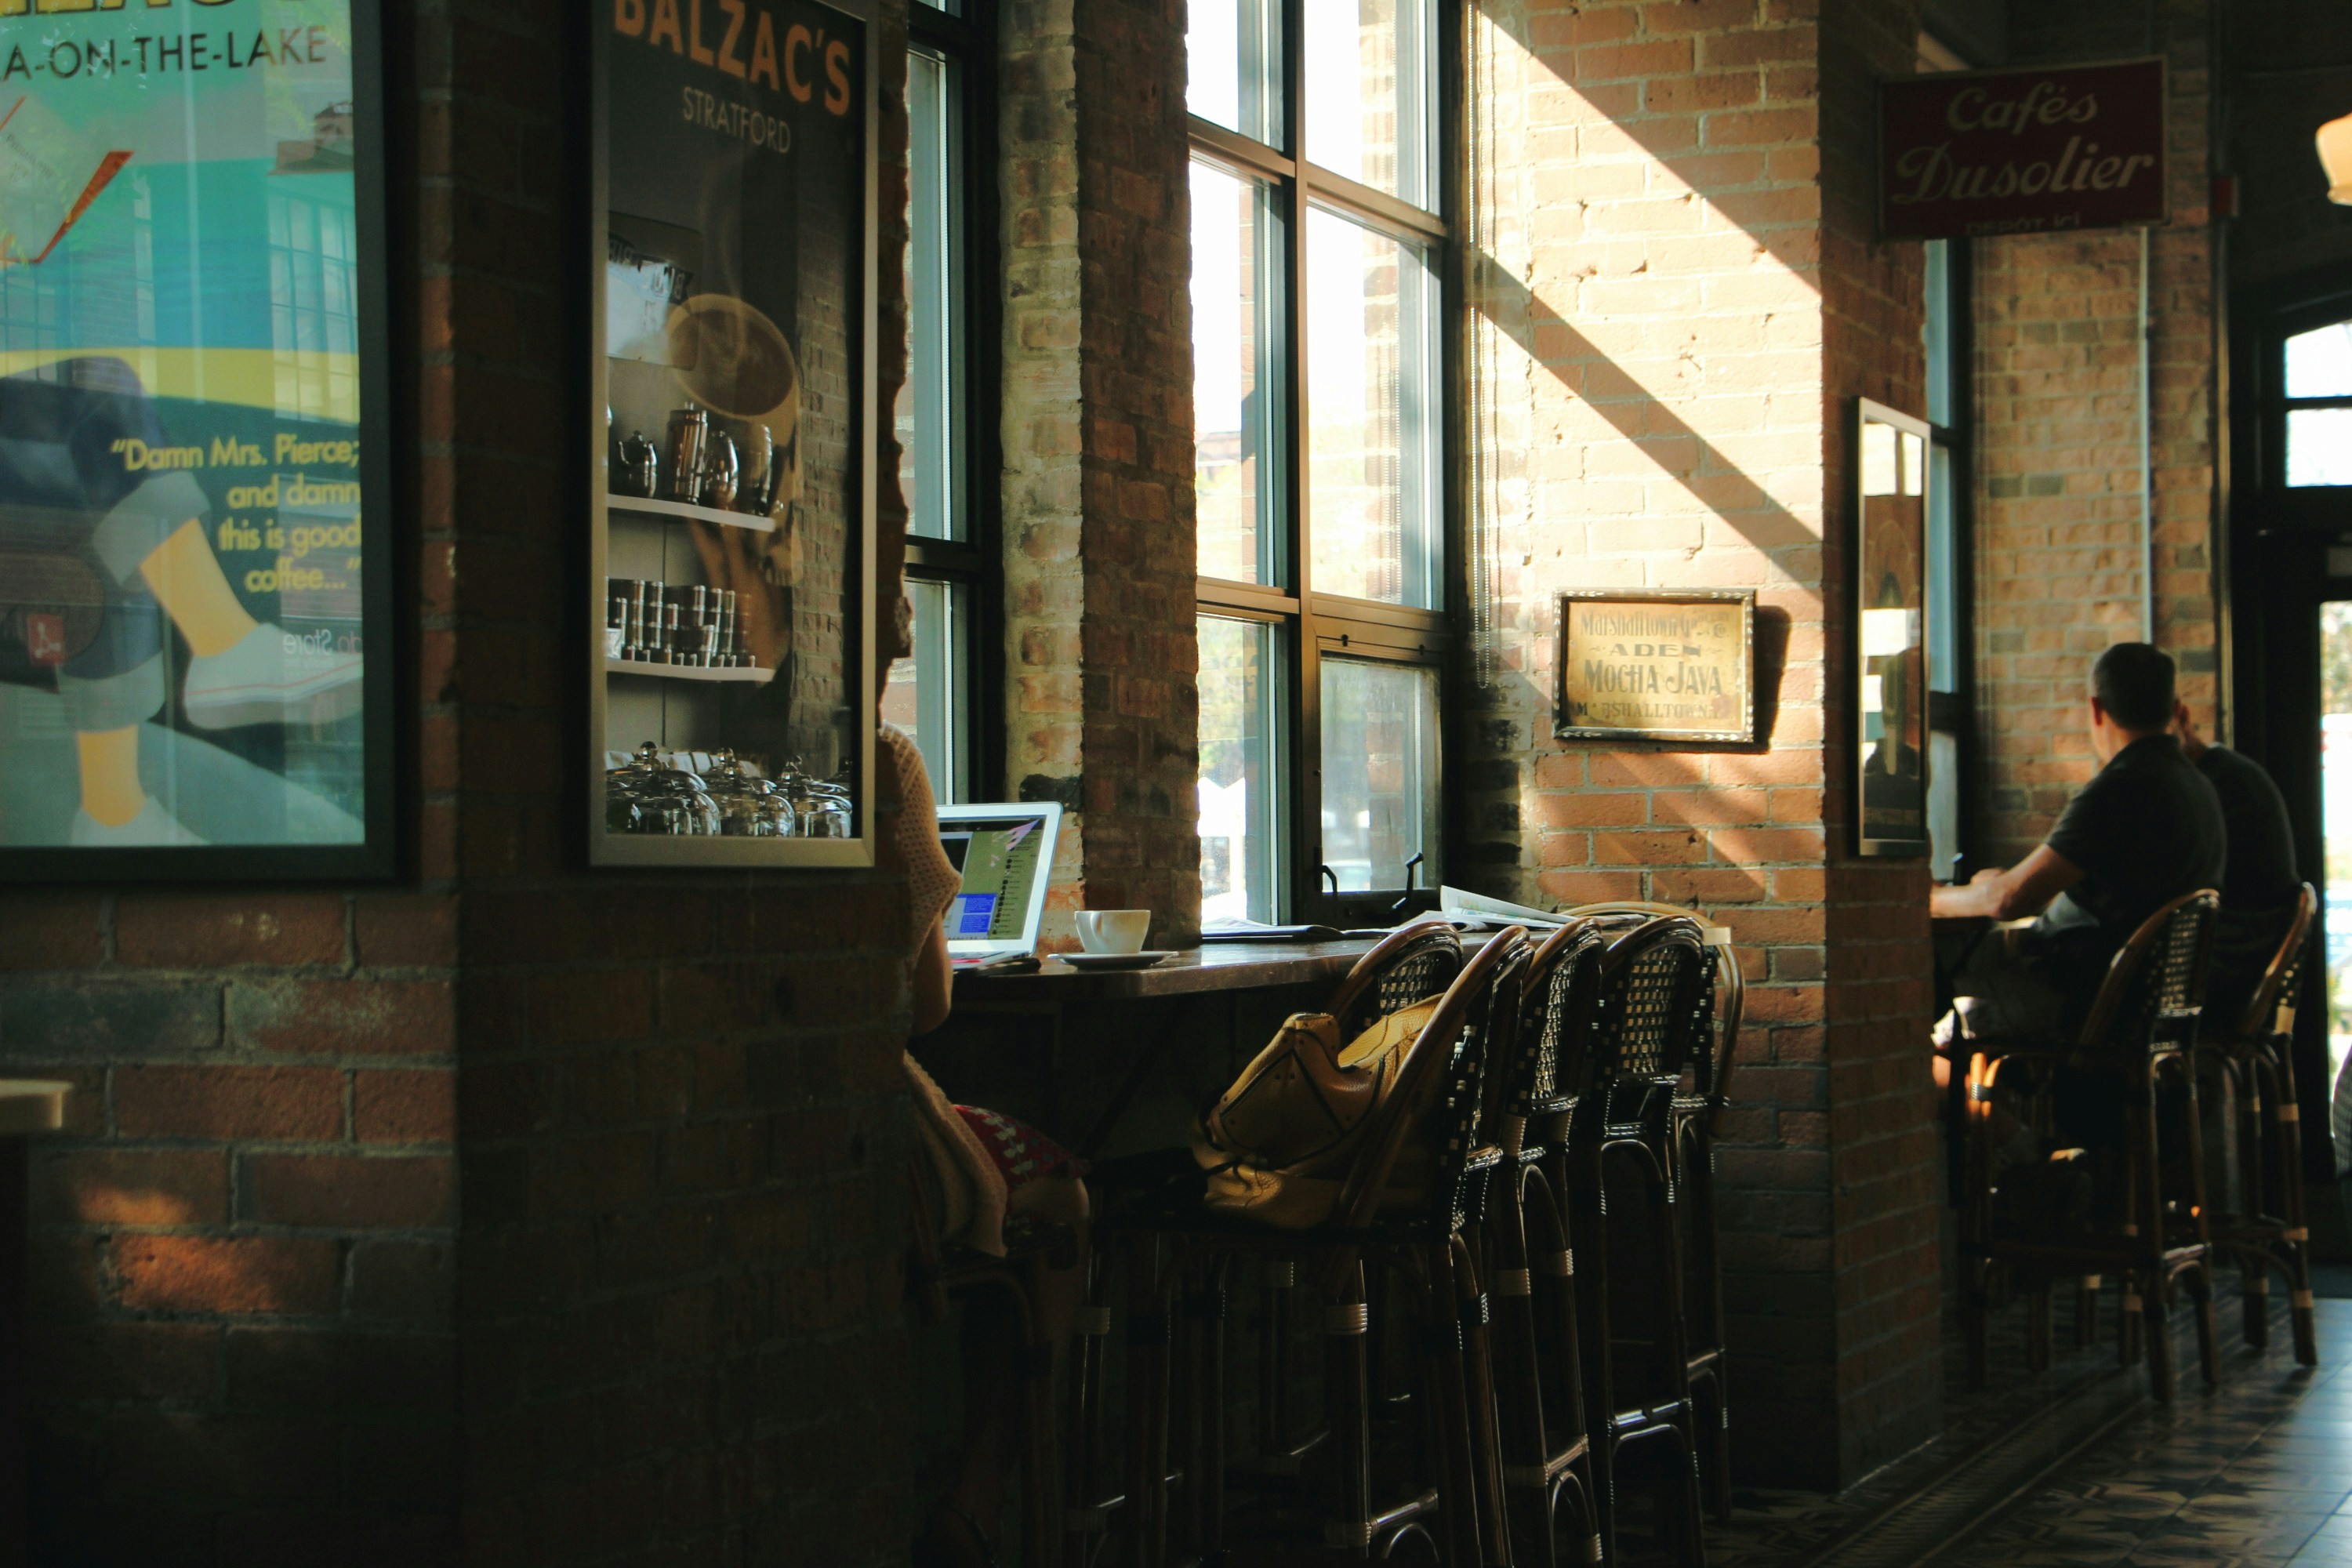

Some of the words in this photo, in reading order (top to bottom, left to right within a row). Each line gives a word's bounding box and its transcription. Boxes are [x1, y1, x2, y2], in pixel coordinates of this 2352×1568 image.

[682, 86, 791, 154] STRATFORD
[1947, 81, 2098, 136] Cafés
[1890, 135, 2154, 204] Dusolier
[210, 436, 267, 467] Mrs.
[227, 473, 279, 509] and
[285, 472, 361, 506] damn
[219, 517, 261, 550] this
[265, 518, 285, 550] is
[290, 514, 361, 557] good
[1609, 643, 1701, 657] ADEN
